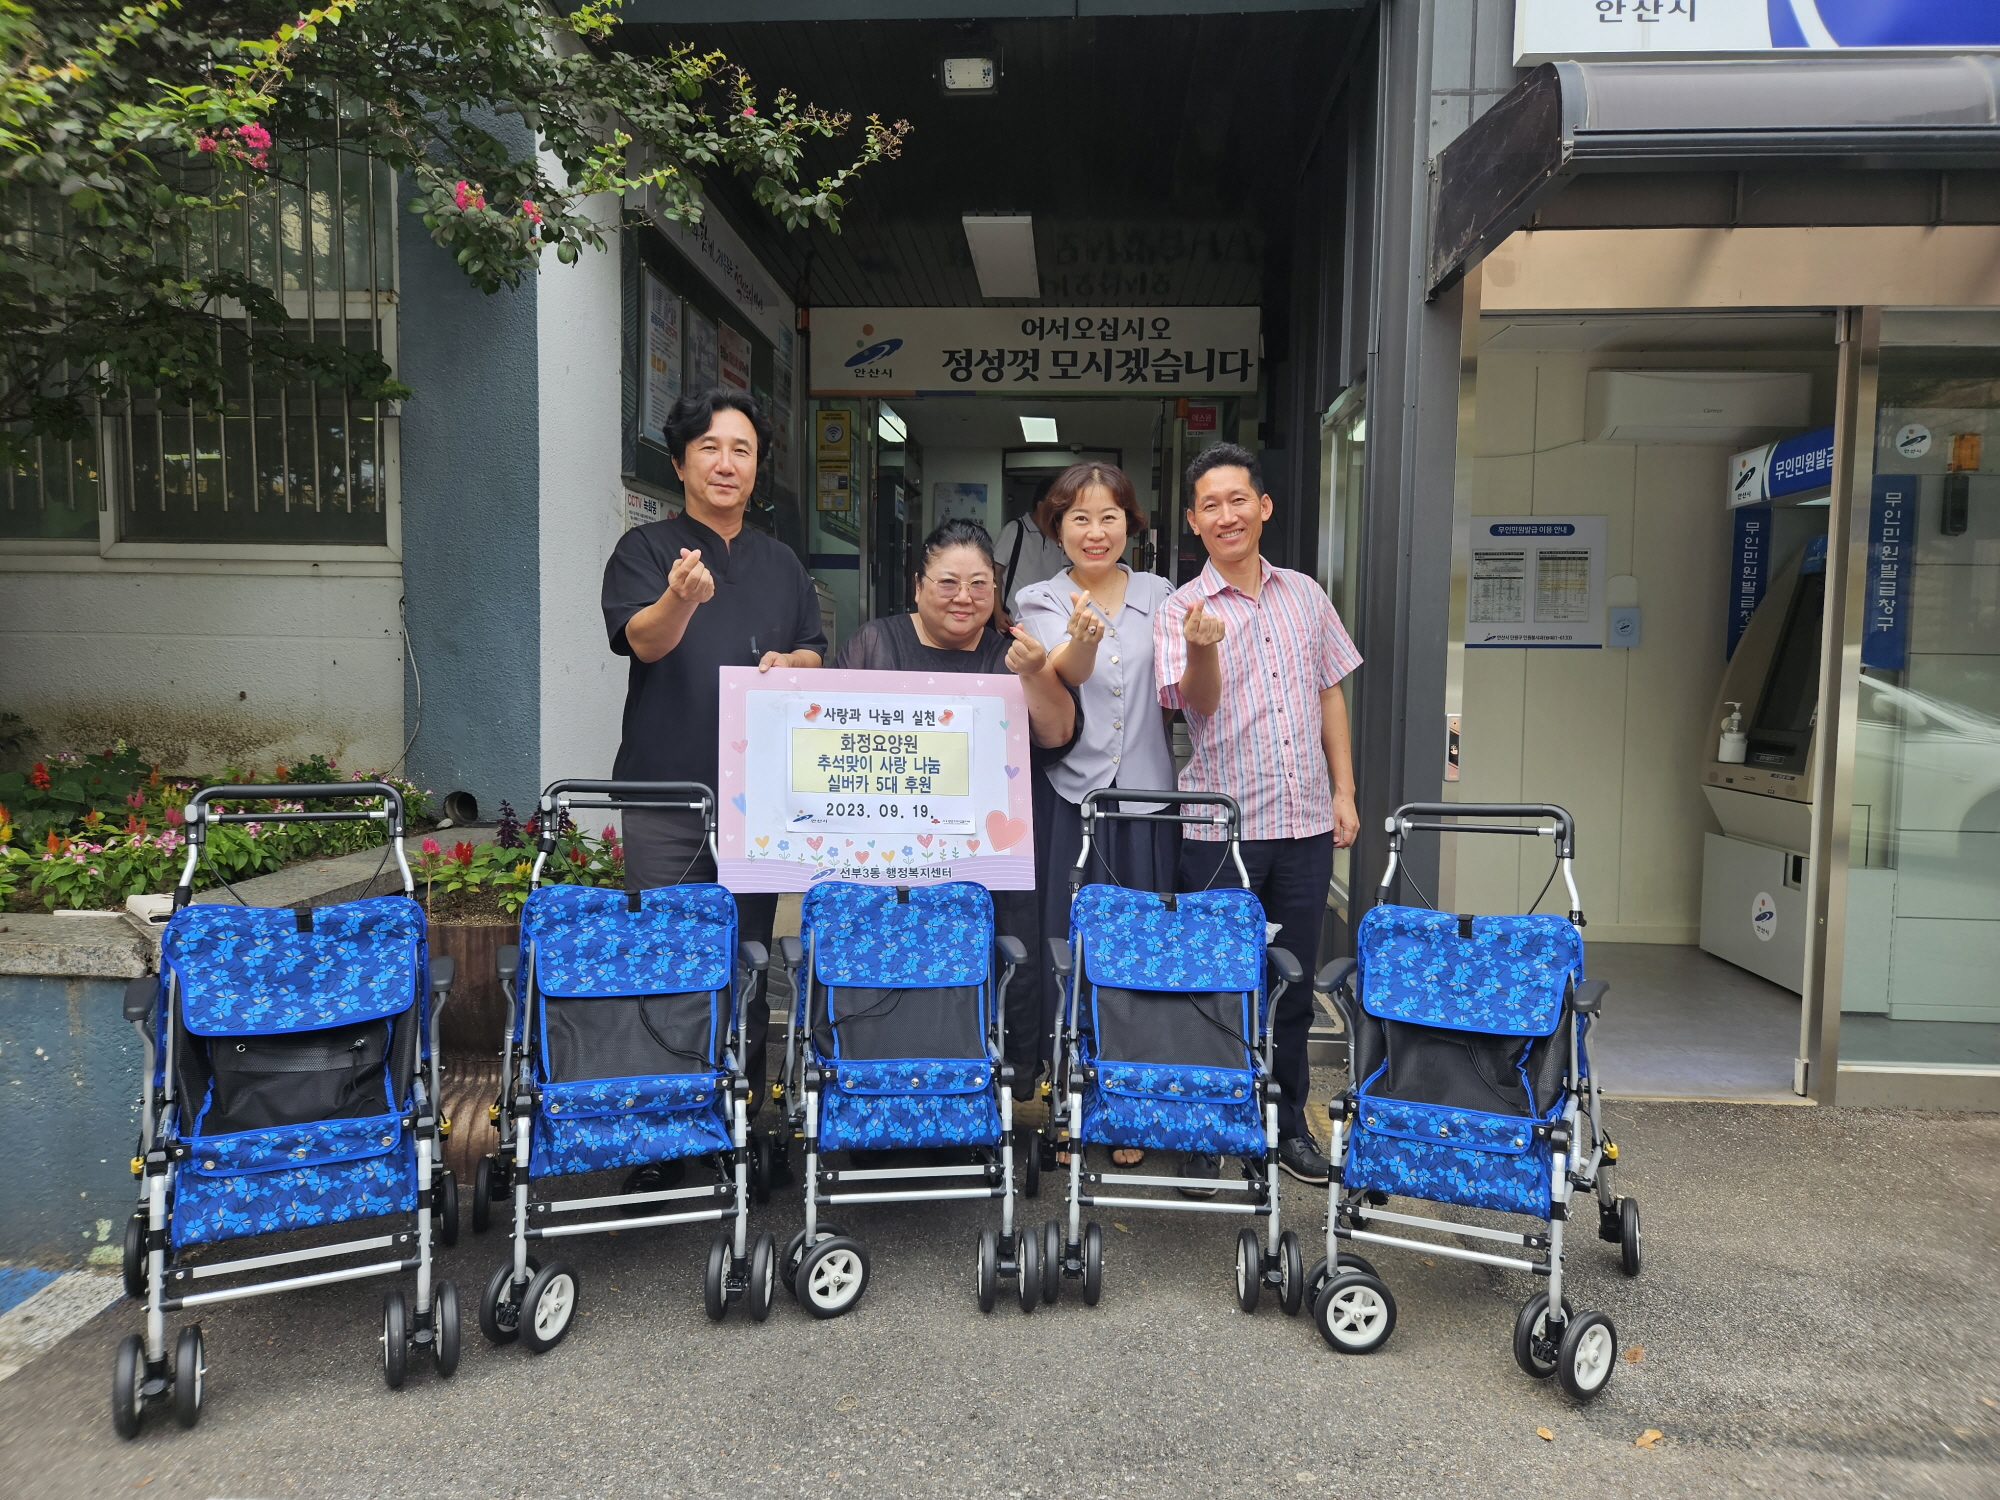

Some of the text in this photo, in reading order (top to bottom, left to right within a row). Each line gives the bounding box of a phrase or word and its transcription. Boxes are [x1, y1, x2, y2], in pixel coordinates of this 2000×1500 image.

[1595, 0, 1696, 23] 안산시
[1021, 316, 1172, 341] 어서오십시오
[854, 368, 893, 378] 안산시
[942, 347, 1254, 384] 정성껏 모시겠습니다
[1191, 413, 1212, 422] 에스원
[627, 493, 657, 515] CCTV 녹화중
[1737, 490, 1752, 500] 안산시
[1498, 526, 1567, 535] 무인민원발급 이용 안내
[1877, 492, 1902, 632] 무인민원발급창구
[824, 708, 936, 727] 사랑과 나눔의 실천
[841, 733, 918, 754] 화정요양원
[817, 754, 941, 774] 추석맞이 사랑 나눔
[828, 775, 931, 794] 실버카 5대 후원
[826, 803, 934, 819] 2023. 09. 19.
[839, 867, 952, 879] 선부3동 행정복지센터
